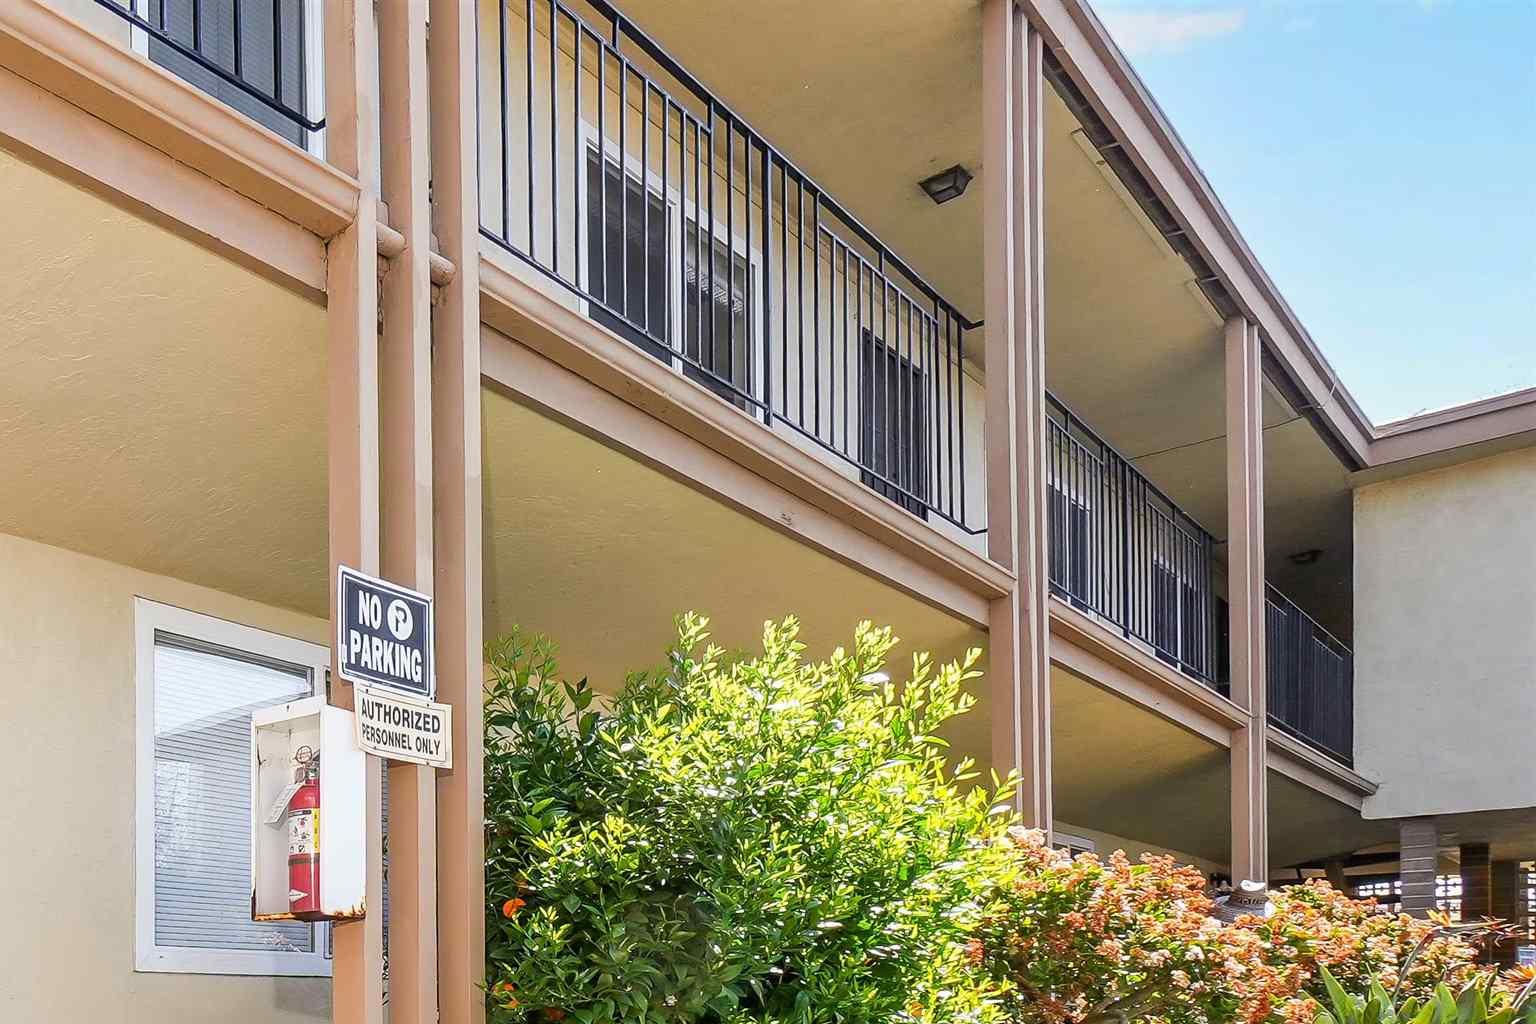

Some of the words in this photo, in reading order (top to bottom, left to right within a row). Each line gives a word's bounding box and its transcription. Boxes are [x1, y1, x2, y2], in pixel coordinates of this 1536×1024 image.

[358, 590, 382, 630] NO
[350, 629, 422, 683] PARKING
[362, 698, 441, 734] AUTHORIZED
[362, 723, 412, 751] PERSONNEL
[415, 736, 441, 756] ONLY
